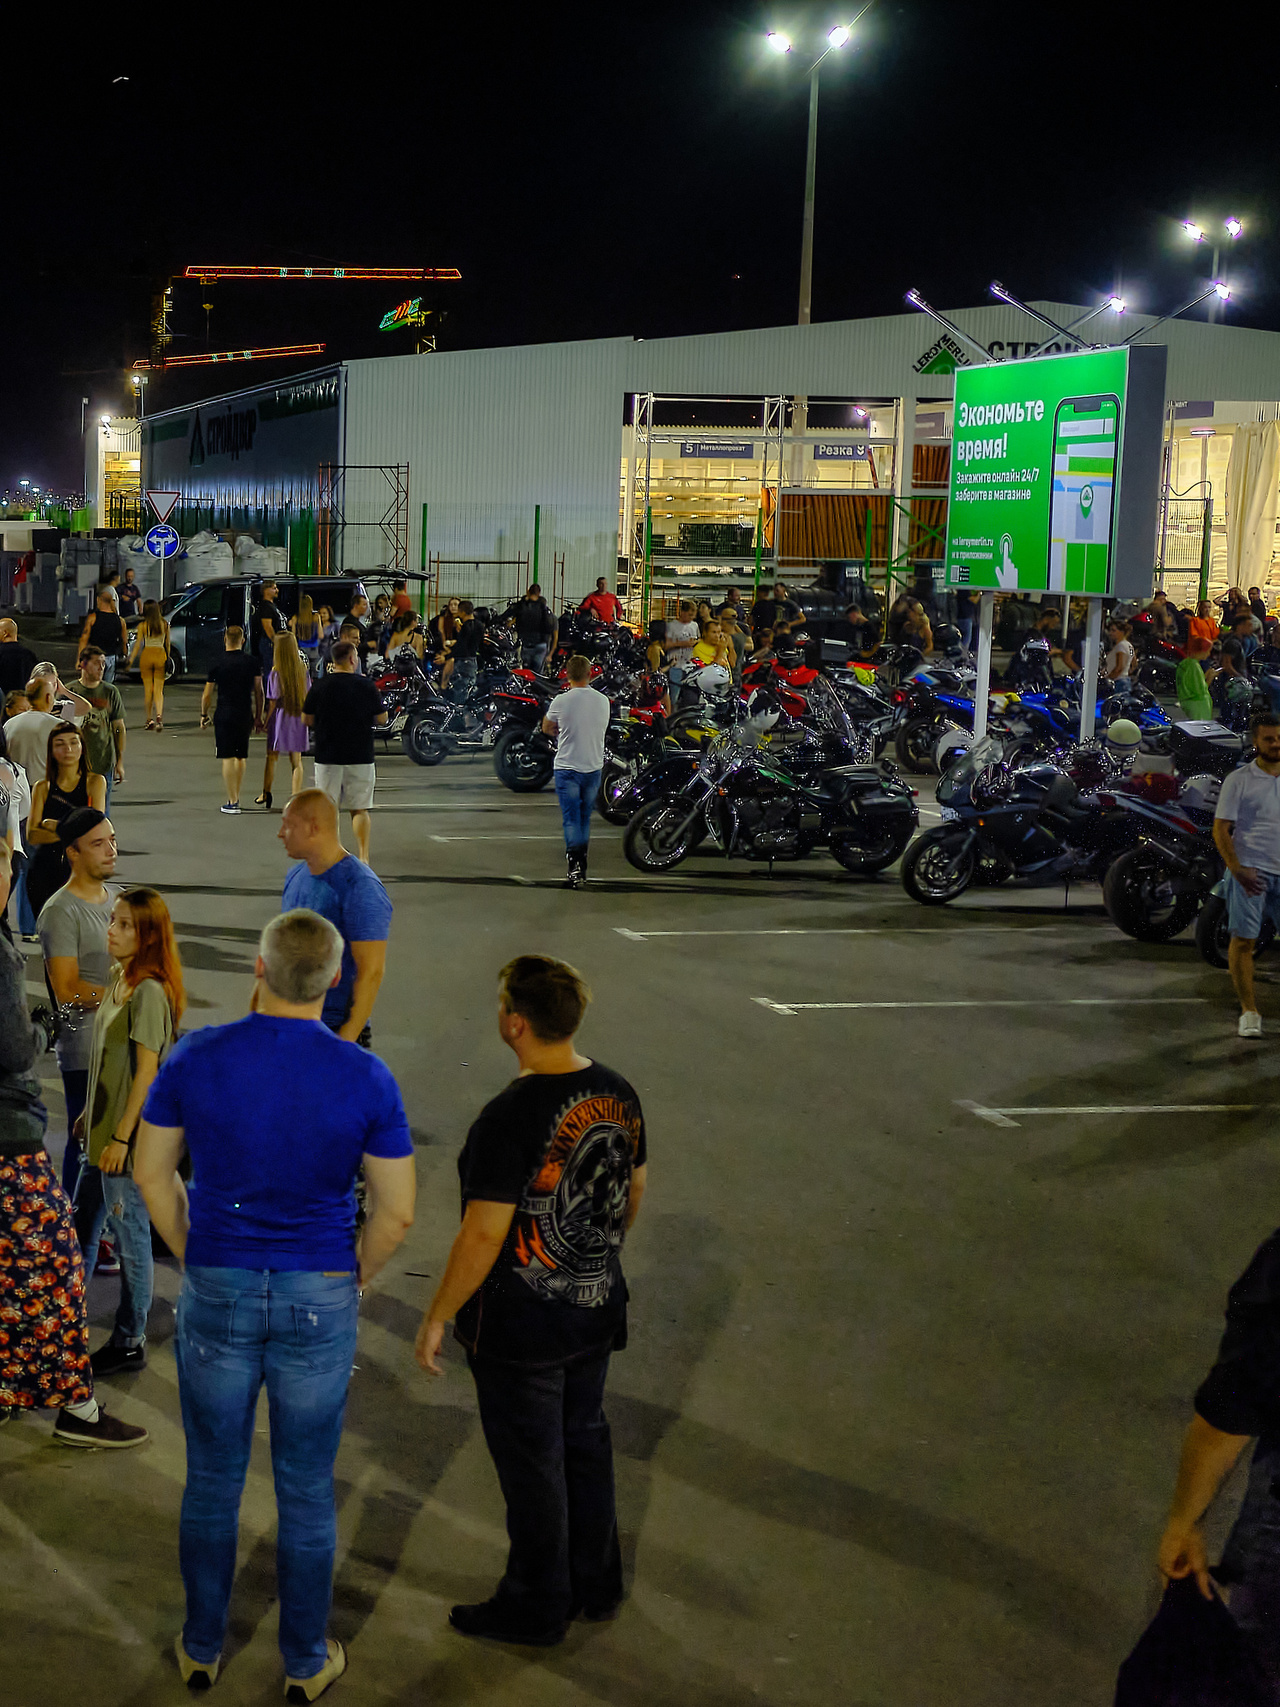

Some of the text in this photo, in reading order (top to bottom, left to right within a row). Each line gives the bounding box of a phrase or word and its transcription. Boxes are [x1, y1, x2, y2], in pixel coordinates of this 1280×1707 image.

[912, 333, 971, 373] LEROY MERLI
[958, 399, 1045, 428] Экономьте
[685, 443, 694, 453] 5
[819, 444, 853, 456] Резка
[957, 432, 1008, 467] время!
[956, 467, 1040, 484] Закажите онлайн 24/7
[955, 487, 1032, 504] заберите в магазине
